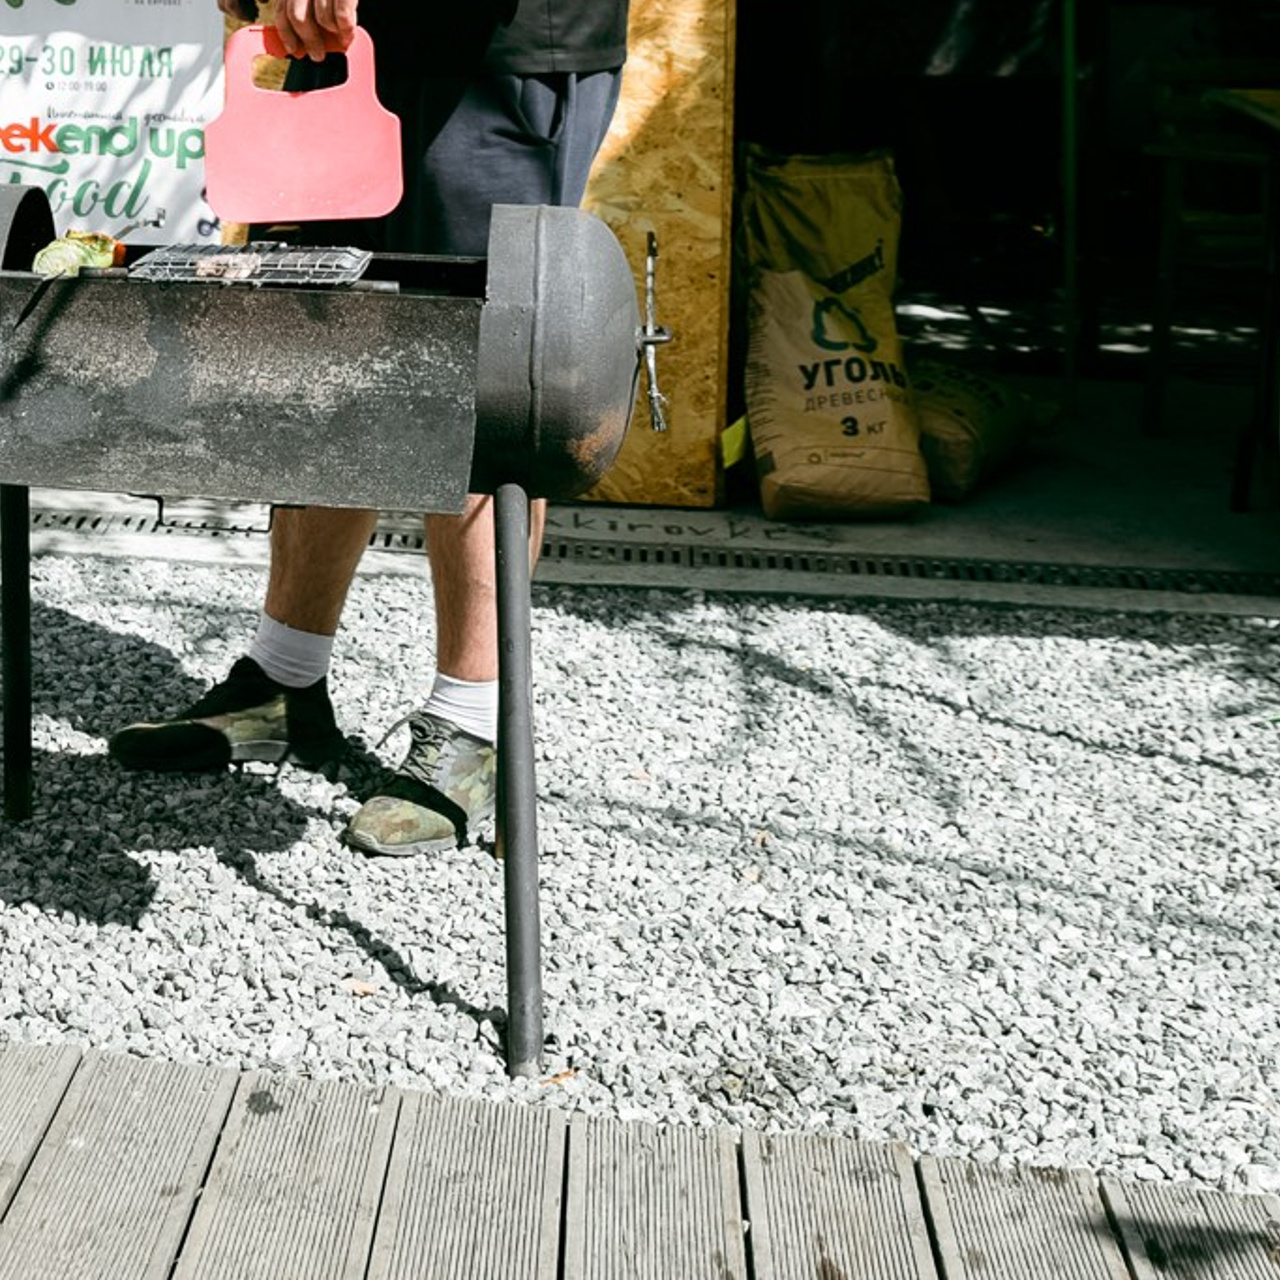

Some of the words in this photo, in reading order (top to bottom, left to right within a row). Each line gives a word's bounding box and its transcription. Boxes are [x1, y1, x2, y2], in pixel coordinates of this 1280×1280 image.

[89, 45, 174, 79] ИЮЛЯ
[149, 124, 205, 169] up
[798, 356, 908, 391] УГОЛЬ
[840, 416, 860, 437] 3
